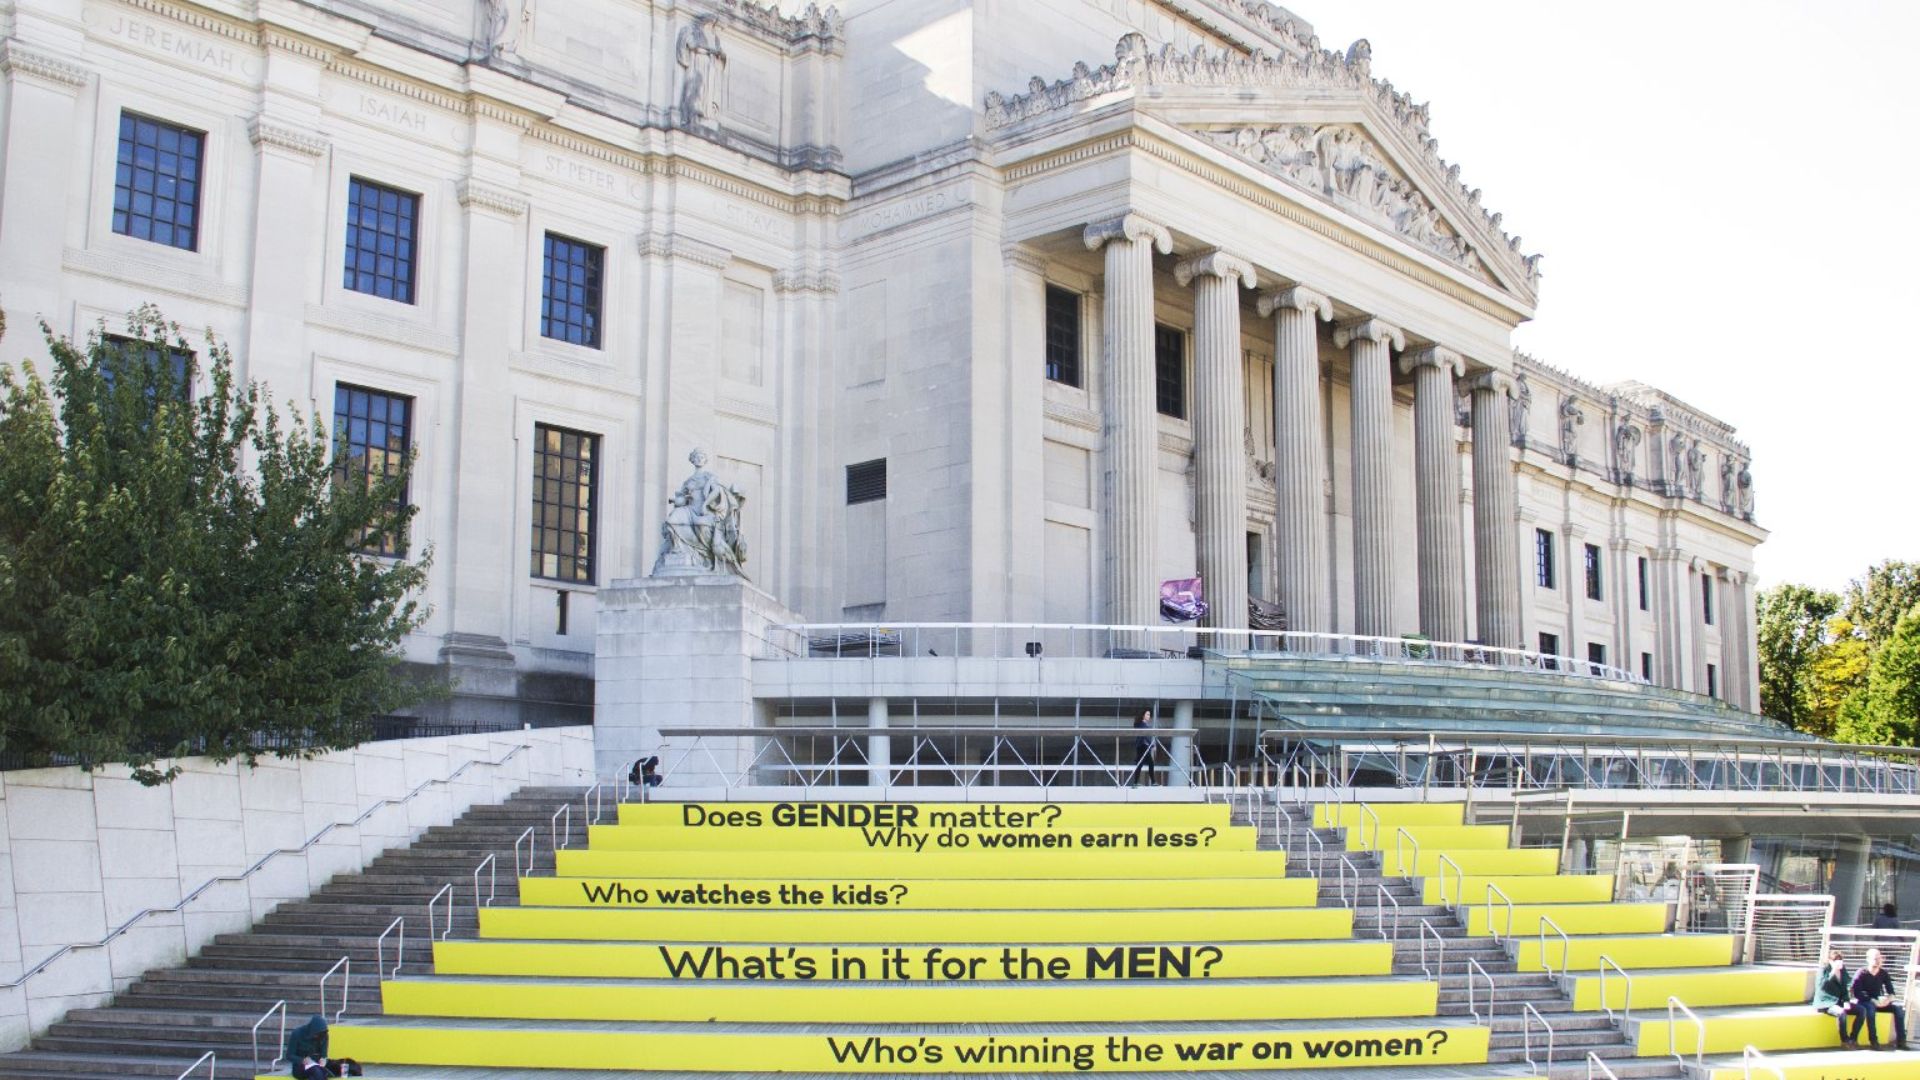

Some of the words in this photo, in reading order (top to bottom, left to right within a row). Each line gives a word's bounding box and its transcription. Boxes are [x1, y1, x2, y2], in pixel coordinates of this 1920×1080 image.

[109, 17, 234, 72] JEREMIAH
[359, 94, 427, 132] ISAIAH
[684, 804, 762, 827] Does
[773, 803, 918, 827] GENDER
[930, 804, 1062, 828] matter?
[863, 827, 929, 852] Why
[937, 828, 970, 848] do
[978, 833, 1072, 848] women
[1081, 833, 1138, 848] earn
[1147, 827, 1217, 848] less?
[583, 883, 649, 904] Who
[657, 884, 771, 905] watches
[779, 885, 824, 905] the
[833, 884, 908, 906] kids?
[658, 946, 817, 979] What's
[832, 948, 866, 979] in
[883, 948, 911, 979] it
[924, 948, 987, 979] for
[1000, 948, 1071, 979] the
[1086, 946, 1223, 978] MEN?
[827, 1037, 943, 1063] Who's
[954, 1037, 1095, 1071] winning
[1105, 1036, 1164, 1062] the
[1174, 1043, 1243, 1061] war
[1252, 1041, 1292, 1060] on
[1303, 1030, 1448, 1058] women?
